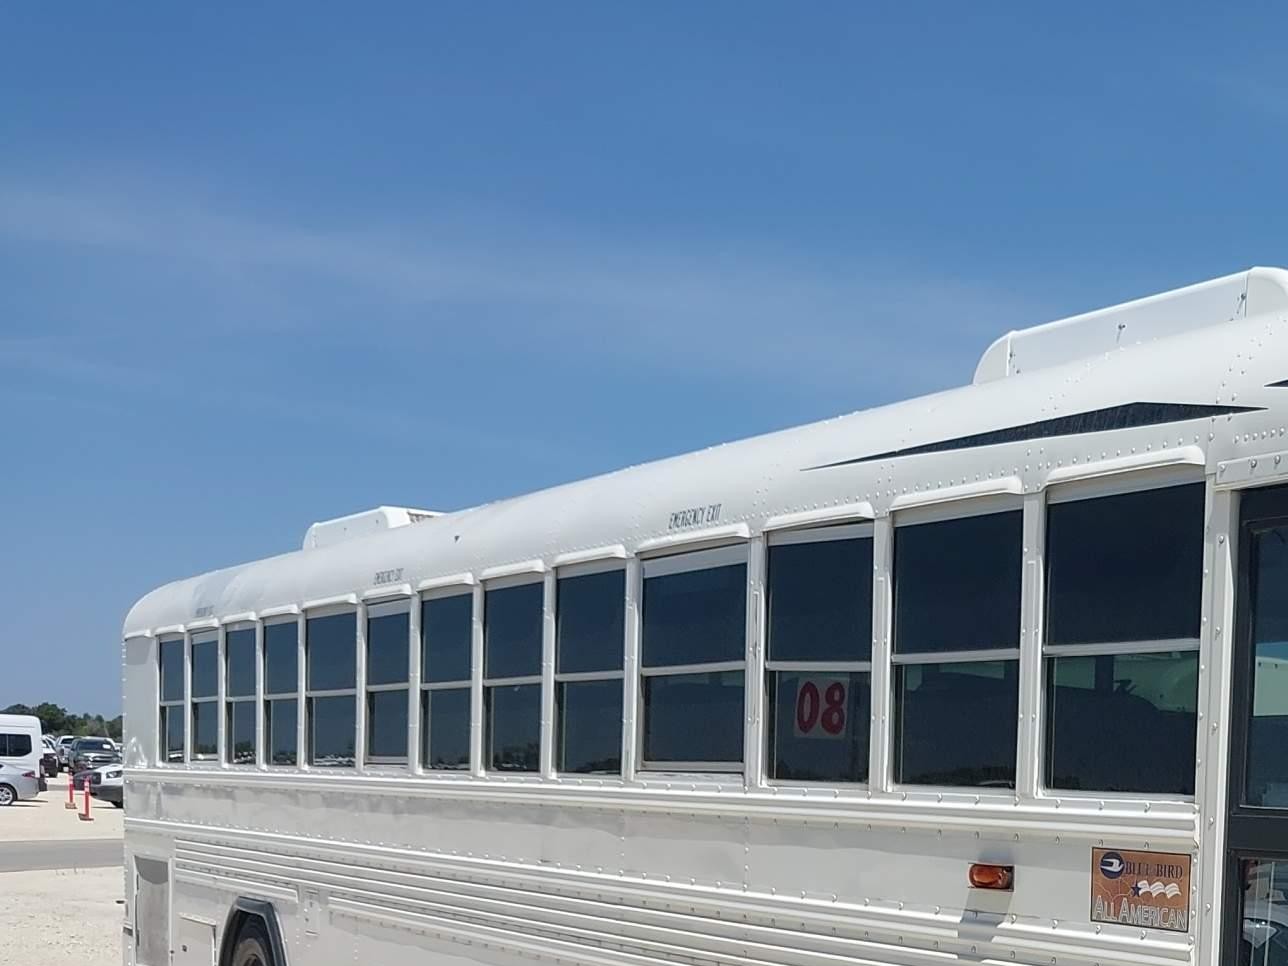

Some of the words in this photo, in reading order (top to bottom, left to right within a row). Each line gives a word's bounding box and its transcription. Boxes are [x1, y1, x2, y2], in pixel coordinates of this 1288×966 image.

[669, 507, 706, 529] EMERGENCY
[706, 503, 722, 521] EXIT
[797, 681, 845, 734] 08
[1155, 863, 1183, 879] BIRD
[1094, 895, 1118, 921] ALL
[1118, 897, 1187, 929] AMERICAN
